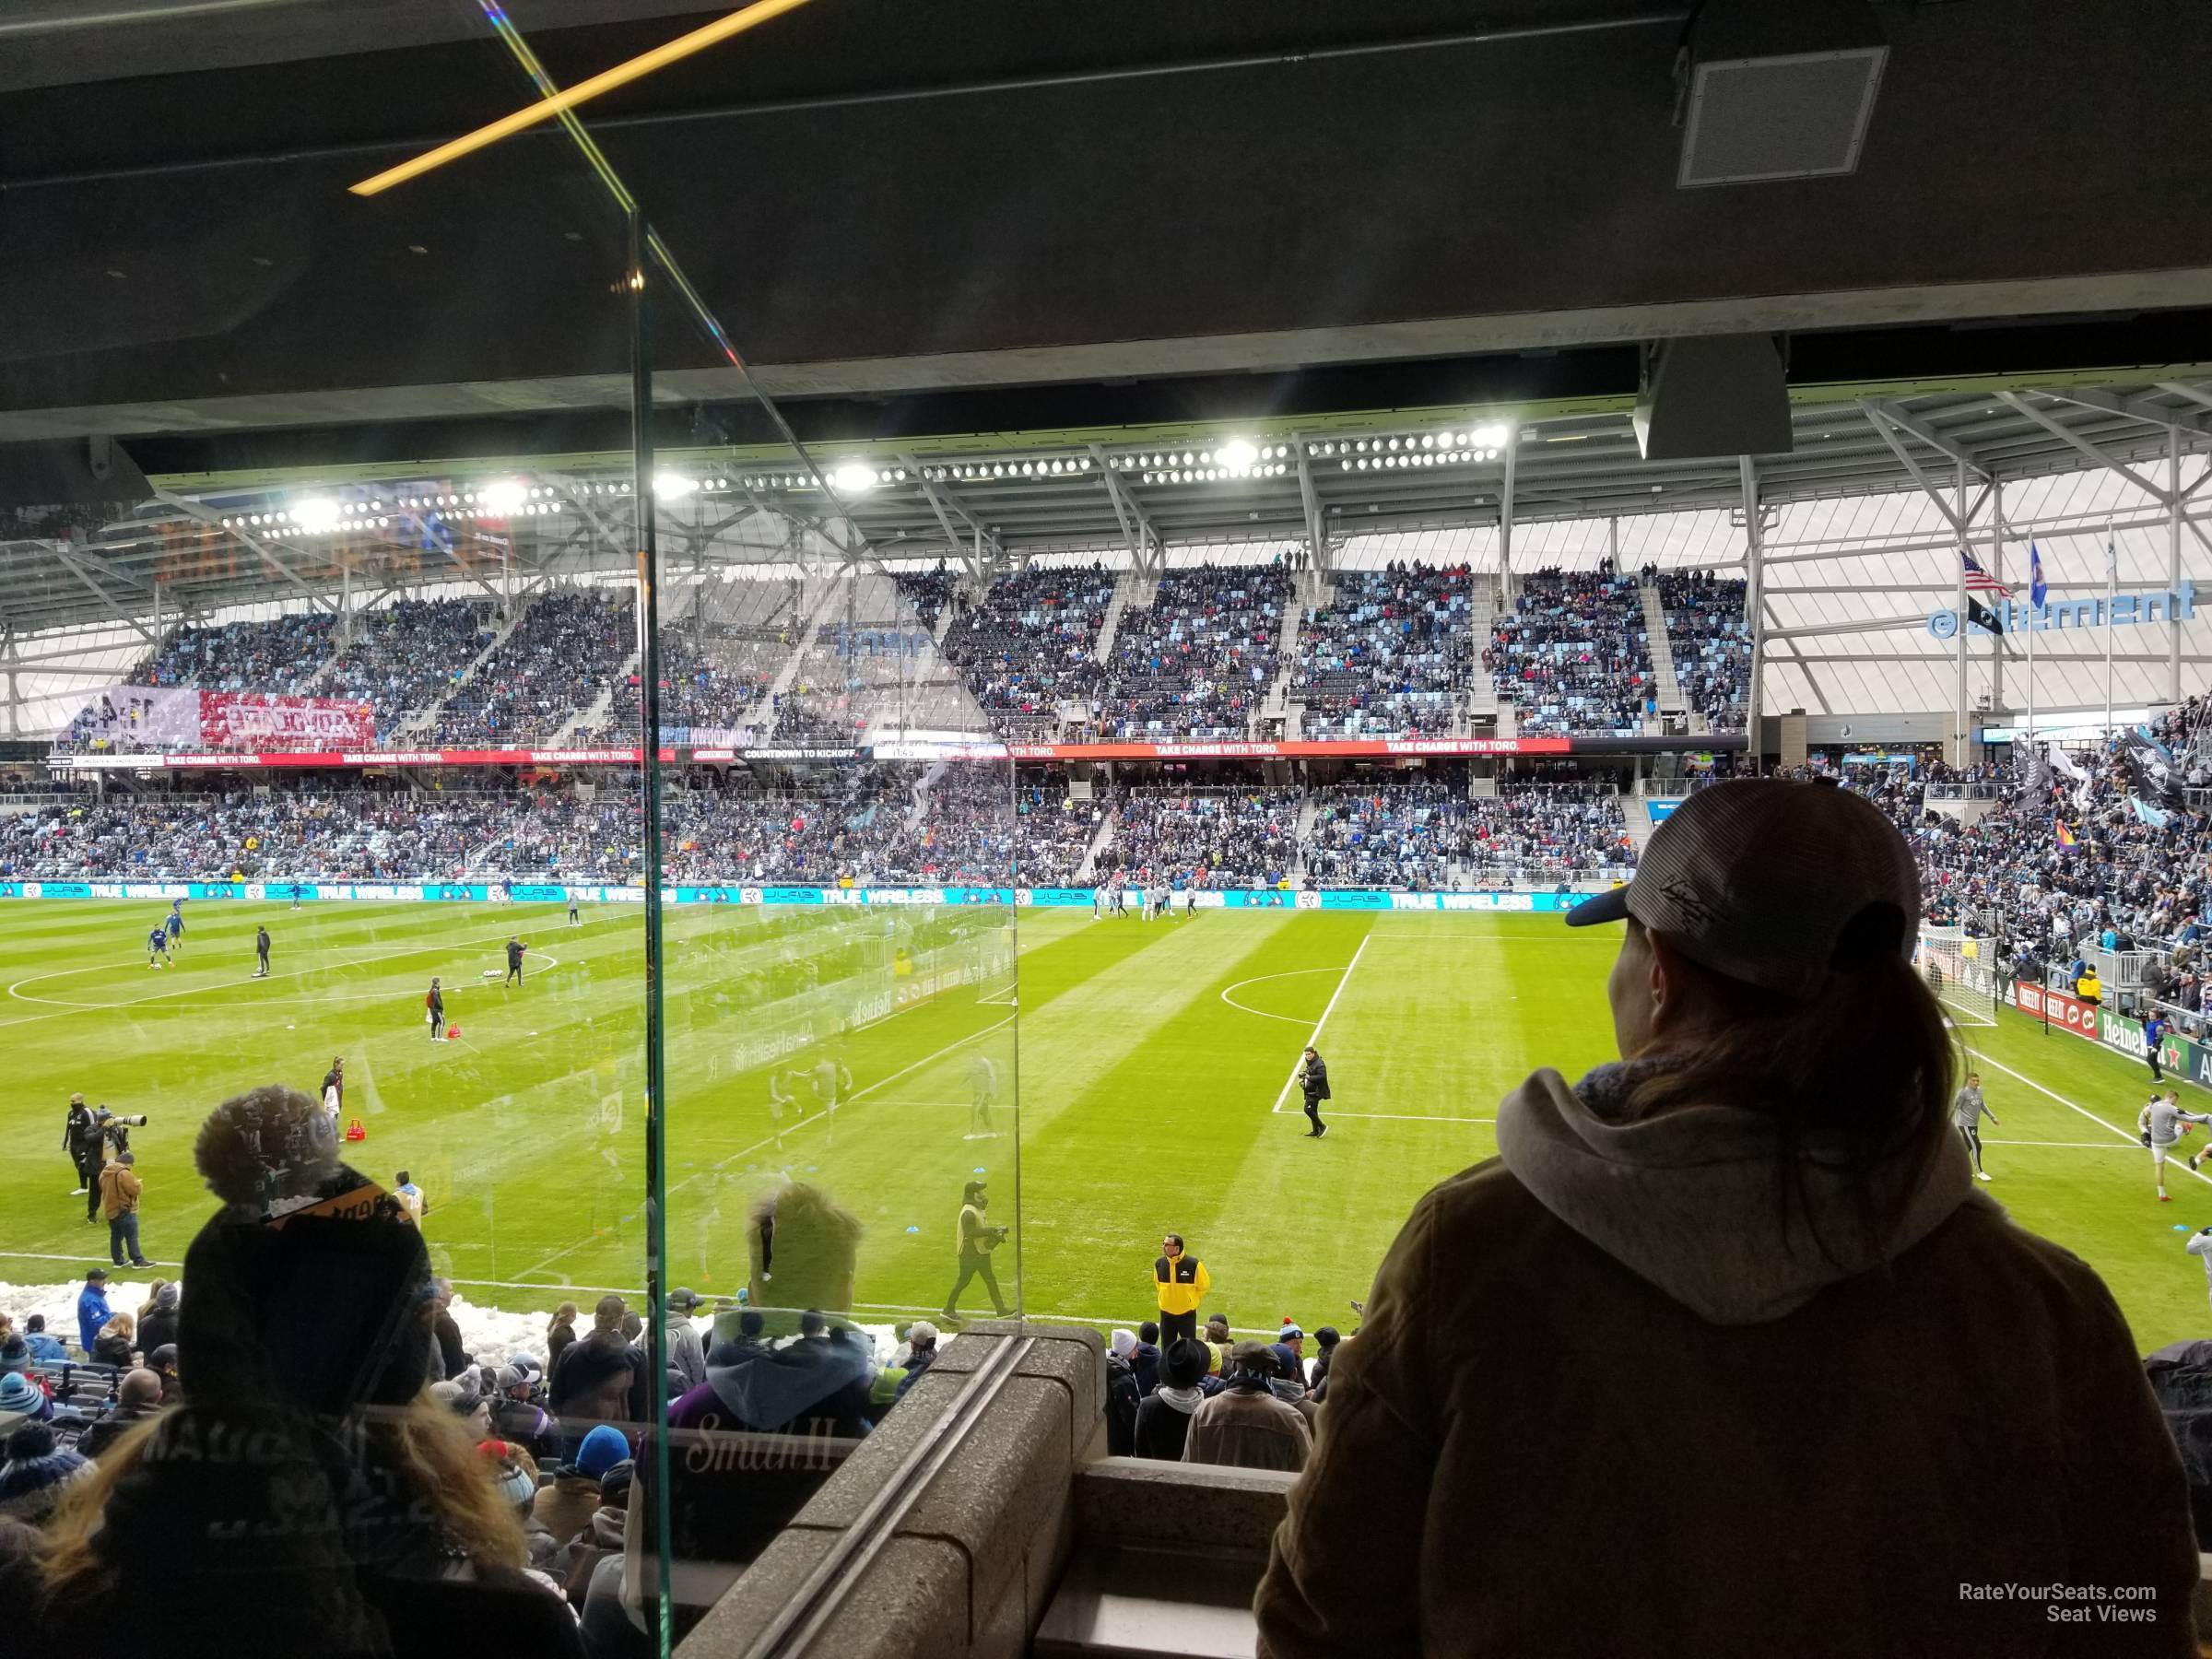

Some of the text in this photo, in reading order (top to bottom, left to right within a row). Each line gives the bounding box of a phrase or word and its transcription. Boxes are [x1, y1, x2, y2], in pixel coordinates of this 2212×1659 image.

[1156, 746, 1181, 755] TAKE
[1182, 745, 1222, 755] CHARGE
[1223, 745, 1250, 754] WITH
[1387, 742, 1414, 752] TAKE
[1415, 741, 1458, 752] CHARGE
[1459, 741, 1487, 751] WITH
[342, 753, 363, 763] TAKE
[364, 753, 396, 763] CHARGE
[397, 753, 418, 762] WITH
[531, 752, 552, 761] TAKE
[553, 751, 587, 761] CHARGE
[588, 751, 610, 760] WITH
[745, 749, 802, 759] COUNTDOWN
[803, 749, 816, 758] TO
[817, 748, 856, 759] KICKOFF
[166, 756, 184, 765] TAKE
[186, 755, 217, 765] CHARGE
[218, 755, 238, 764] WITH
[89, 884, 190, 899] TRUE WIRELESS
[317, 885, 424, 900] TRUE WIRELESS
[820, 888, 946, 904] TRUE WIRELESS
[1390, 893, 1534, 911] TRUE WIRELESS
